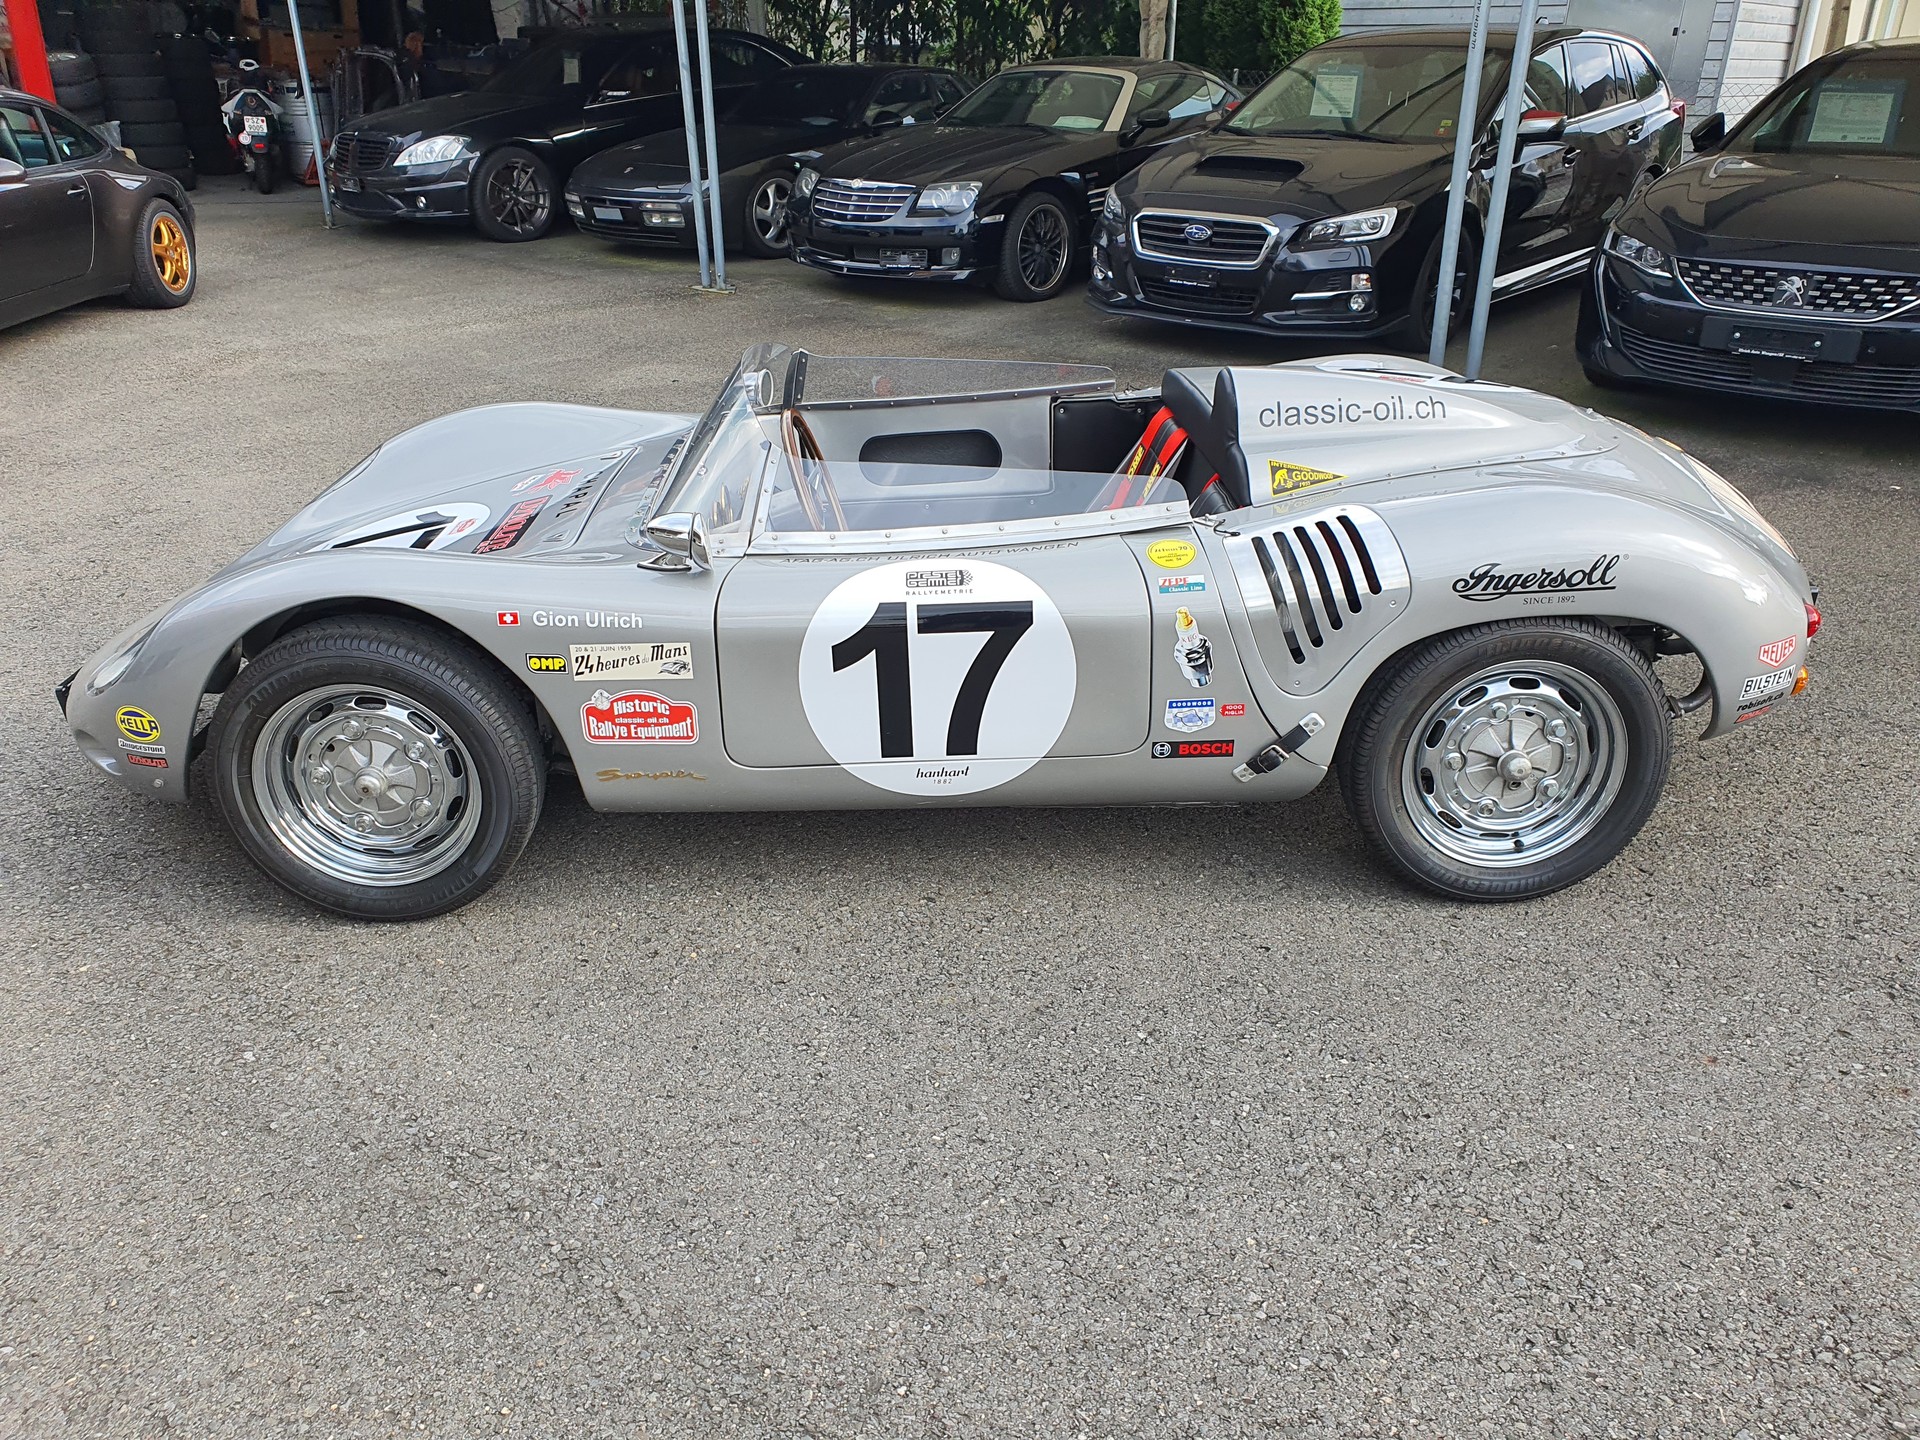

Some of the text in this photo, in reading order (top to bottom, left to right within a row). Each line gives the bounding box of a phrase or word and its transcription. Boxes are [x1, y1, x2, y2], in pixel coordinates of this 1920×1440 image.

[1471, 14, 1480, 50] ULRICH
[1259, 395, 1446, 427] classic-oil.ch
[1292, 470, 1334, 481] GOODWOOD
[887, 553, 950, 561] ULRICH
[1006, 541, 1079, 553] WANGEN
[1452, 554, 1620, 601] Ingersoll
[905, 588, 973, 596] RALLYEMETRIE
[1523, 595, 1576, 605] SINCE 1892
[532, 610, 643, 629] Gion Ulrich
[574, 653, 595, 677] 24
[595, 654, 641, 673] heures
[650, 644, 688, 662] Mans
[1761, 639, 1795, 664] HEUER
[831, 600, 1034, 759] 17
[1743, 668, 1794, 694] BILSTEIN
[612, 698, 671, 716] Historic
[119, 716, 160, 734] HELLA
[588, 715, 694, 739] Rallye Equipment
[614, 716, 670, 724] classic-oil.ch
[119, 740, 164, 753] BRIDGESTONE
[1178, 742, 1234, 756] BOSCH
[915, 765, 970, 779] hanhart
